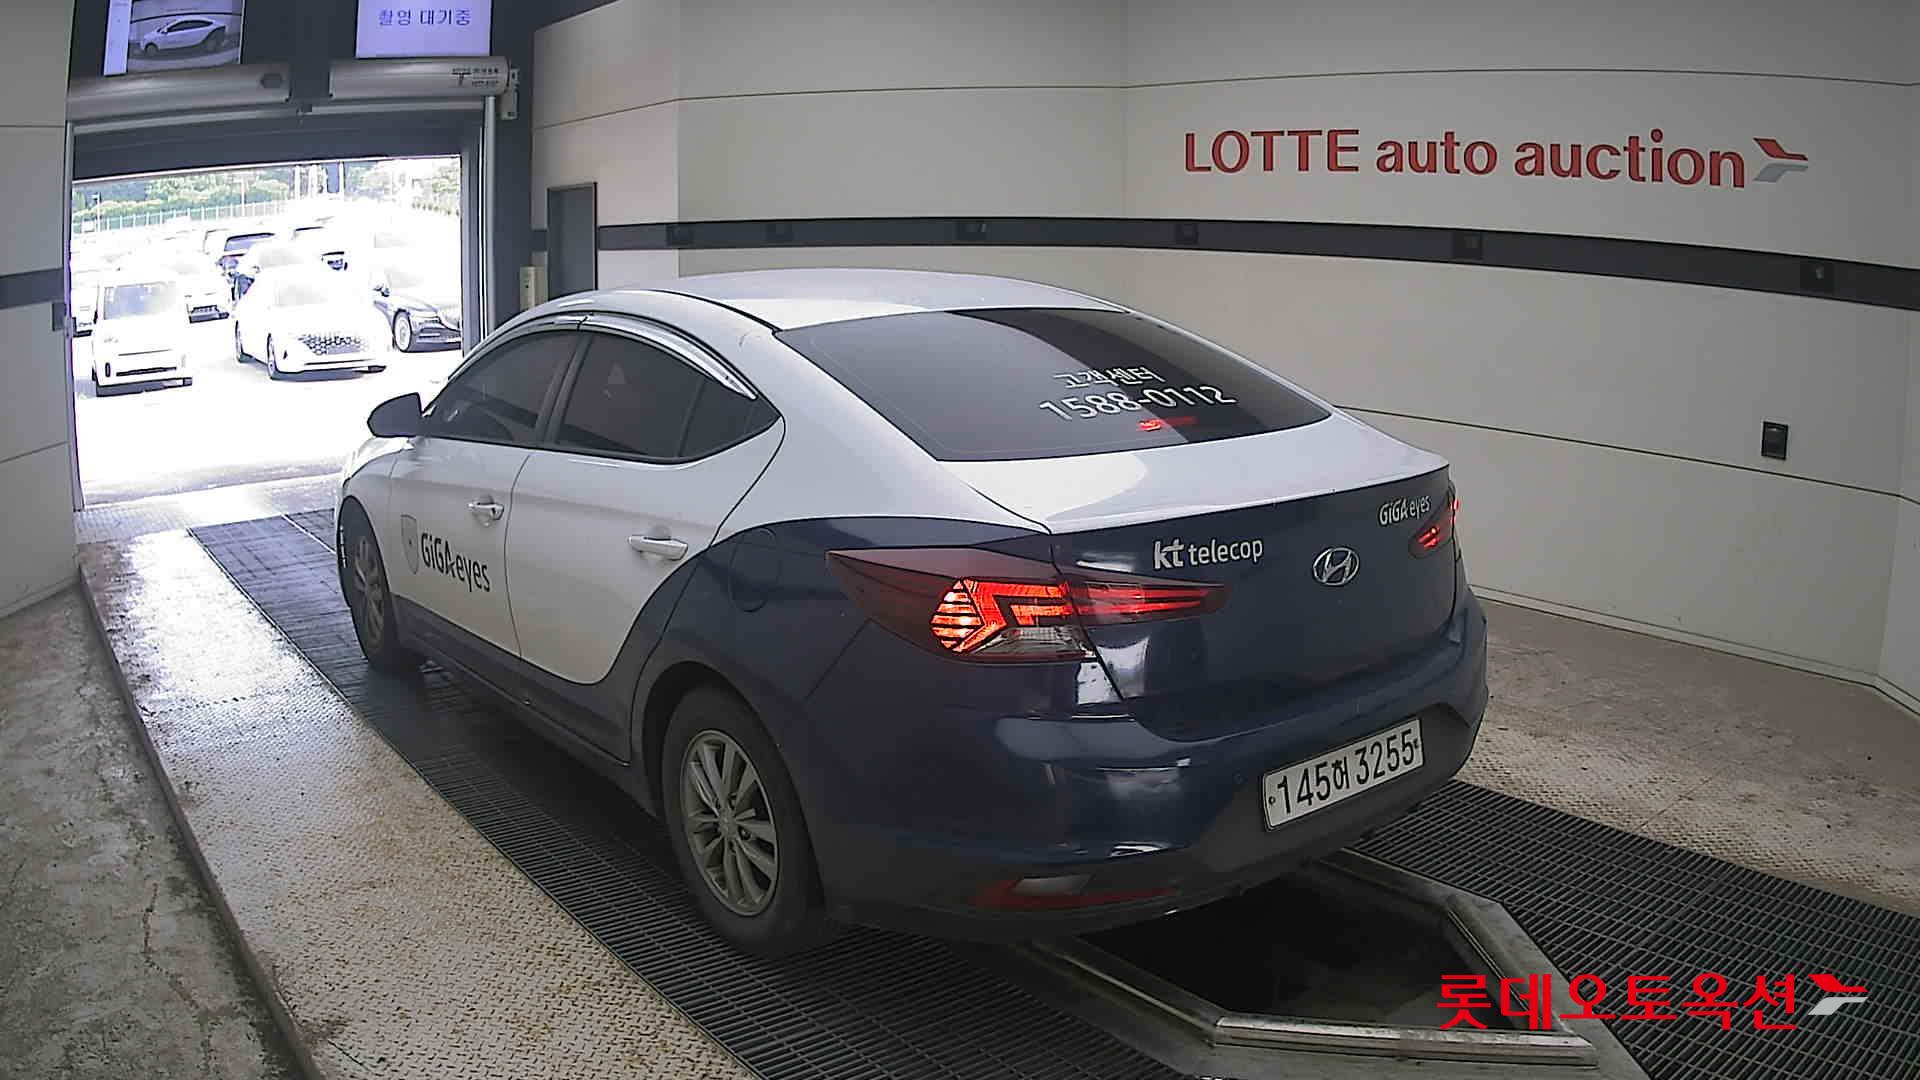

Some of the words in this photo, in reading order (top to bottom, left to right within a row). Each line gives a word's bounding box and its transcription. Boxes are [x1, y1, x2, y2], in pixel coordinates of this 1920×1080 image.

[420, 9, 471, 26] 대기중
[1185, 129, 1360, 174] LOTTE
[1376, 131, 1499, 176] auto
[1514, 128, 1746, 189] auction
[1053, 366, 1167, 389] 고객센터
[1039, 386, 1238, 421] 1588-0112
[1153, 538, 1185, 570] kt
[1188, 538, 1263, 566] telecop
[1277, 756, 1350, 814] 145허
[1354, 728, 1416, 785] 3255
